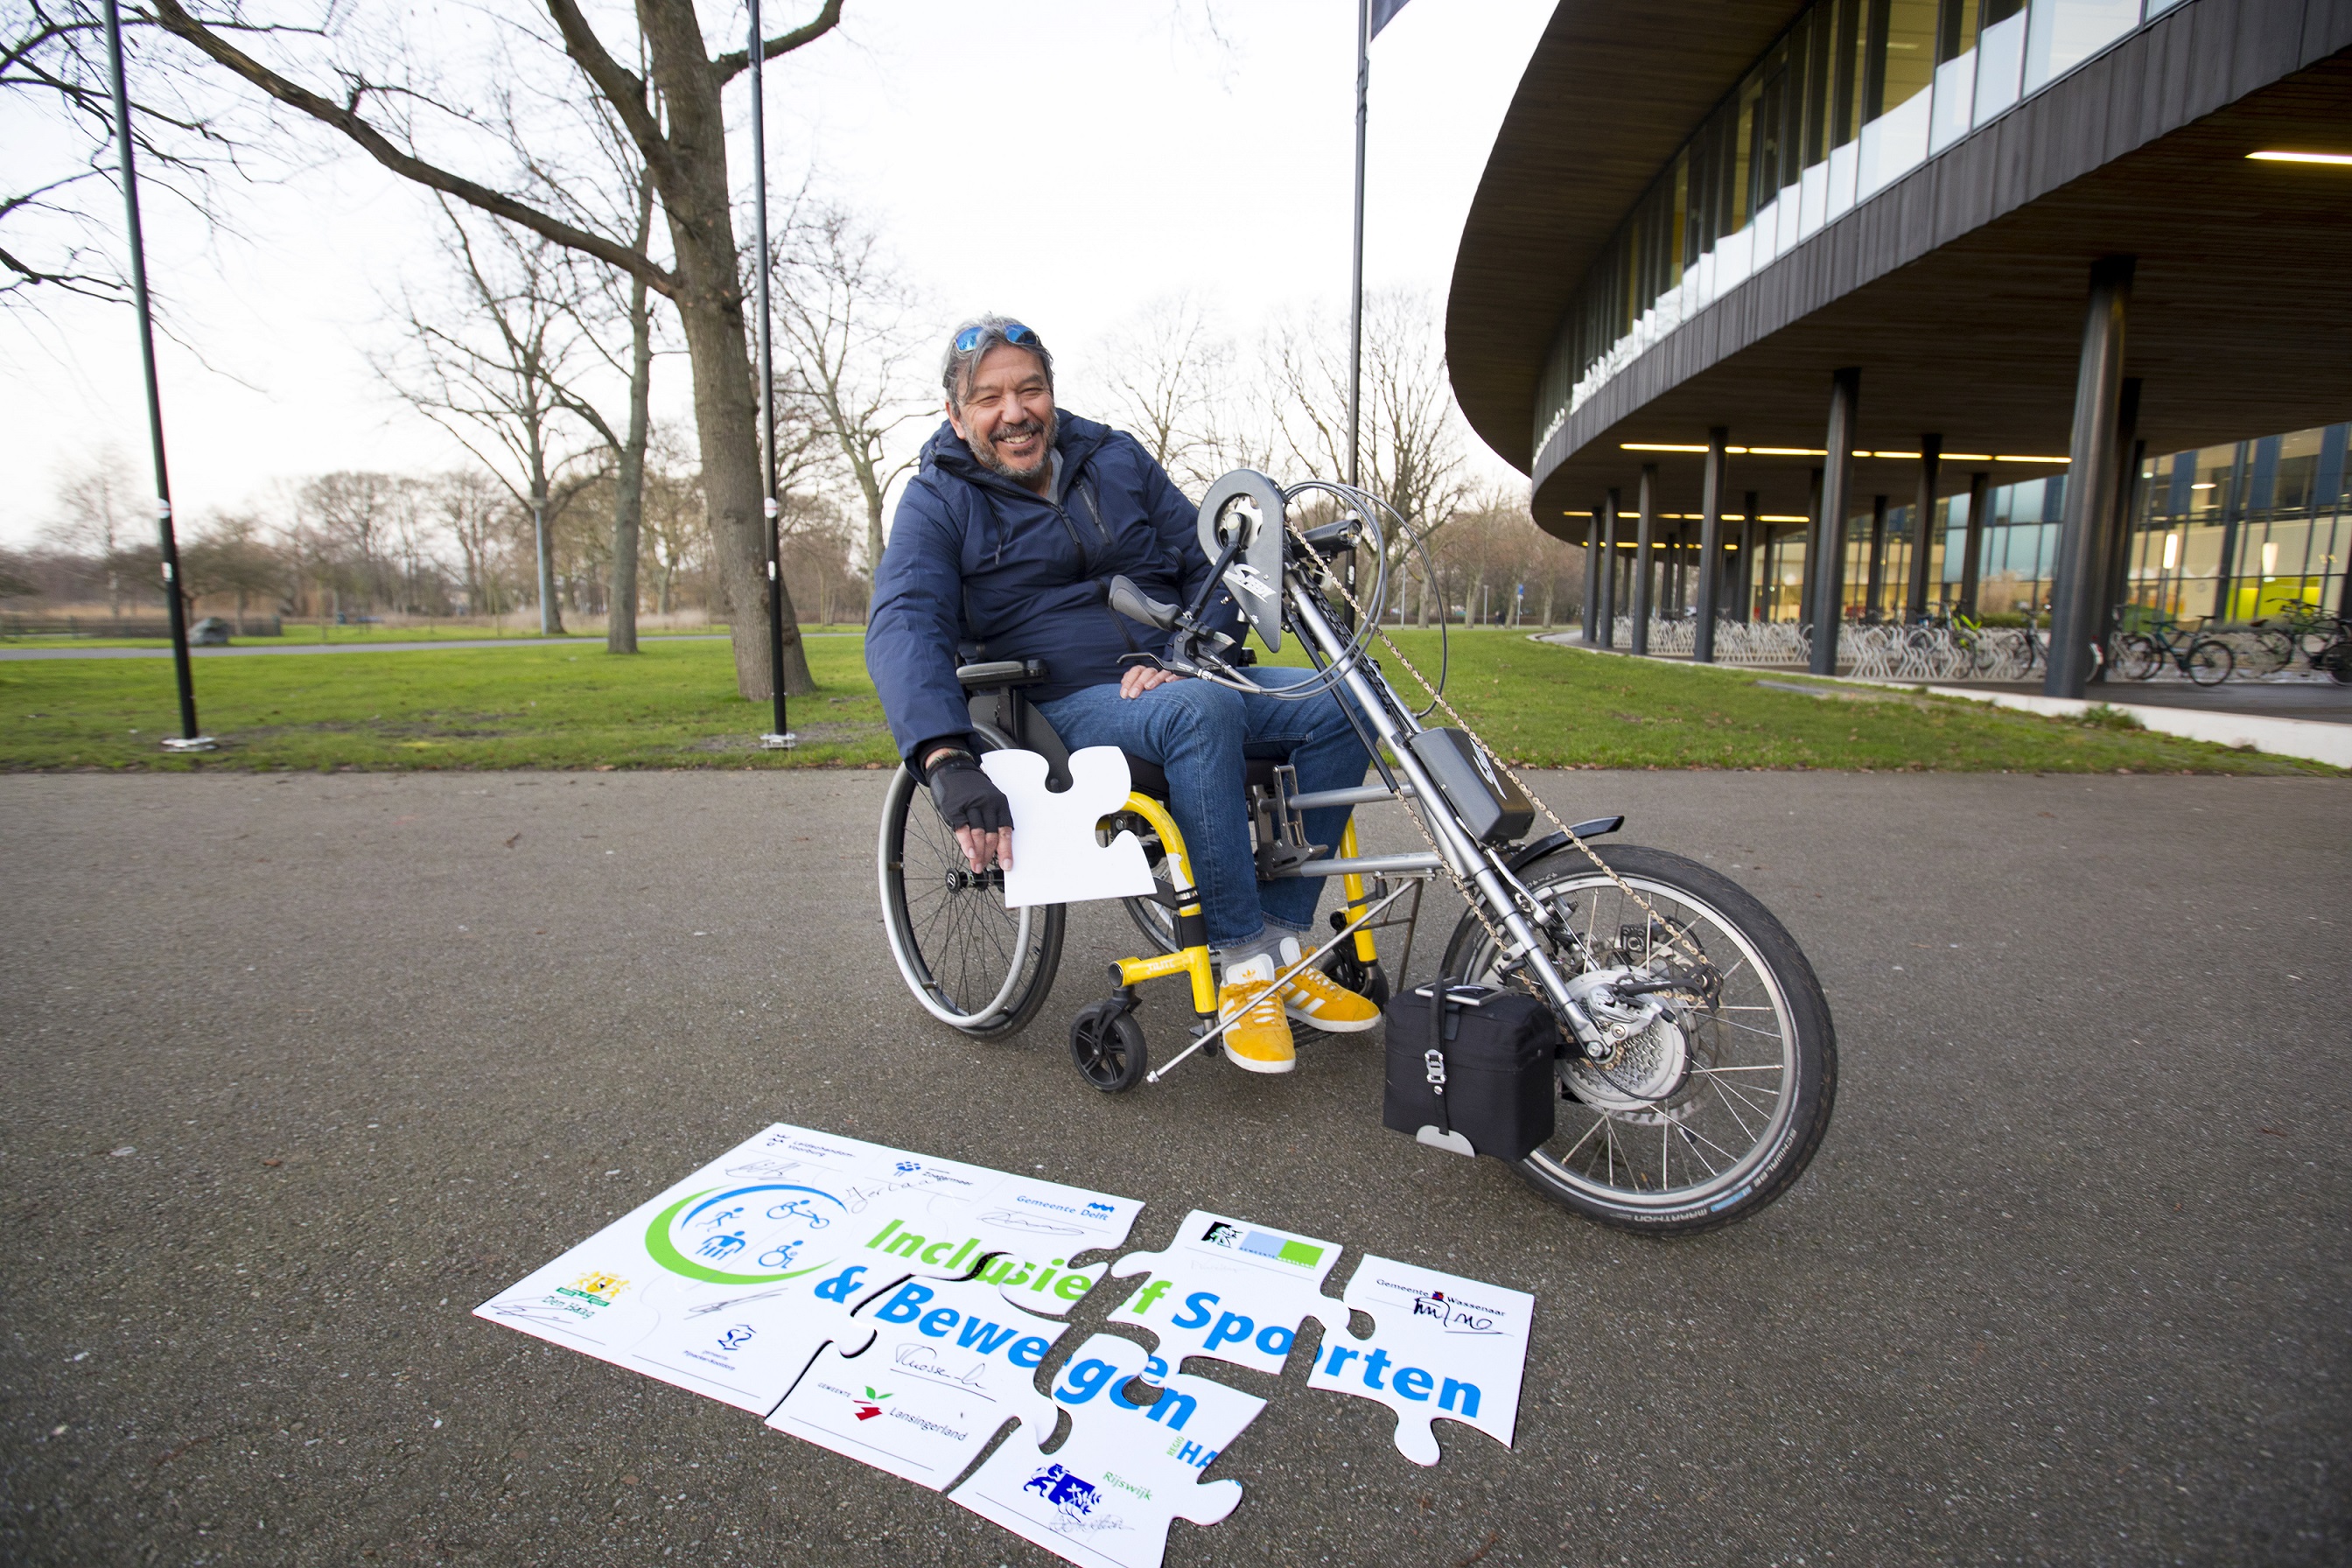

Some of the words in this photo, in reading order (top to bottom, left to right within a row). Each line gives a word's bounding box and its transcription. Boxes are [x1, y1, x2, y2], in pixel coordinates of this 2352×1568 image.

[1754, 1128, 1797, 1187] SCHWALBE
[1016, 1195, 1076, 1214] Gemeente
[1081, 1208, 1109, 1222] Delft
[1634, 1208, 1708, 1222] MARATHON
[815, 1265, 869, 1304] &
[1376, 1278, 1429, 1297] Gemeente
[1446, 1296, 1506, 1317] Wassenaar
[542, 1296, 565, 1307] Den
[564, 1303, 595, 1319] Haag
[889, 1407, 969, 1441] Lansingerland
[1166, 1435, 1185, 1457] REGIO
[1102, 1471, 1152, 1501] Rijswijk
